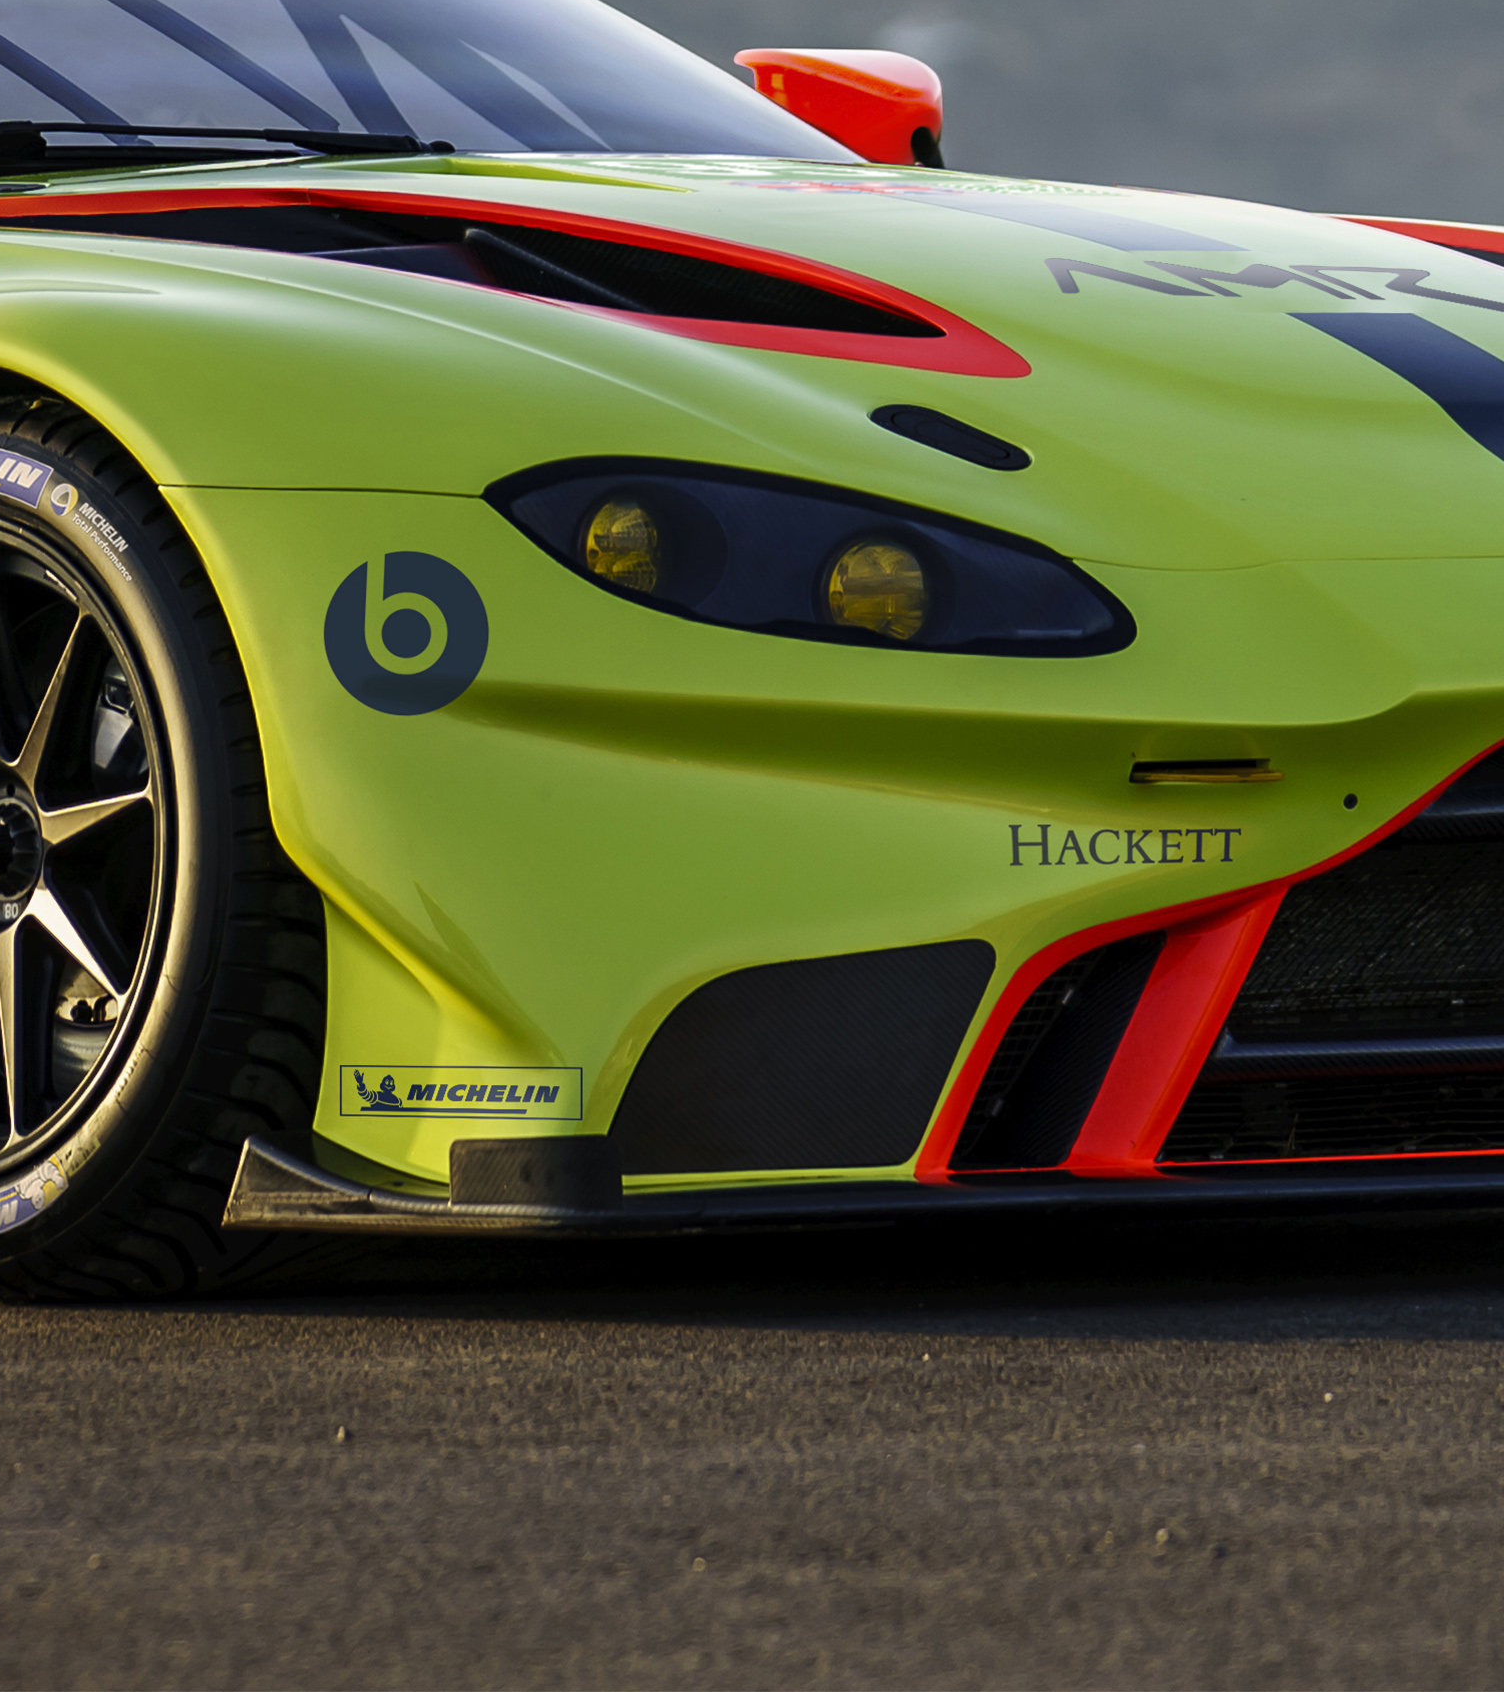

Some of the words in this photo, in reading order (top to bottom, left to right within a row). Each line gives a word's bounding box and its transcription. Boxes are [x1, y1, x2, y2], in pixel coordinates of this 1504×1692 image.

[71, 513, 94, 536] Total
[89, 529, 133, 582] Performance
[79, 502, 129, 553] MICHELIN
[1008, 824, 1242, 867] HACKETT
[407, 1083, 560, 1104] MICHELIN
